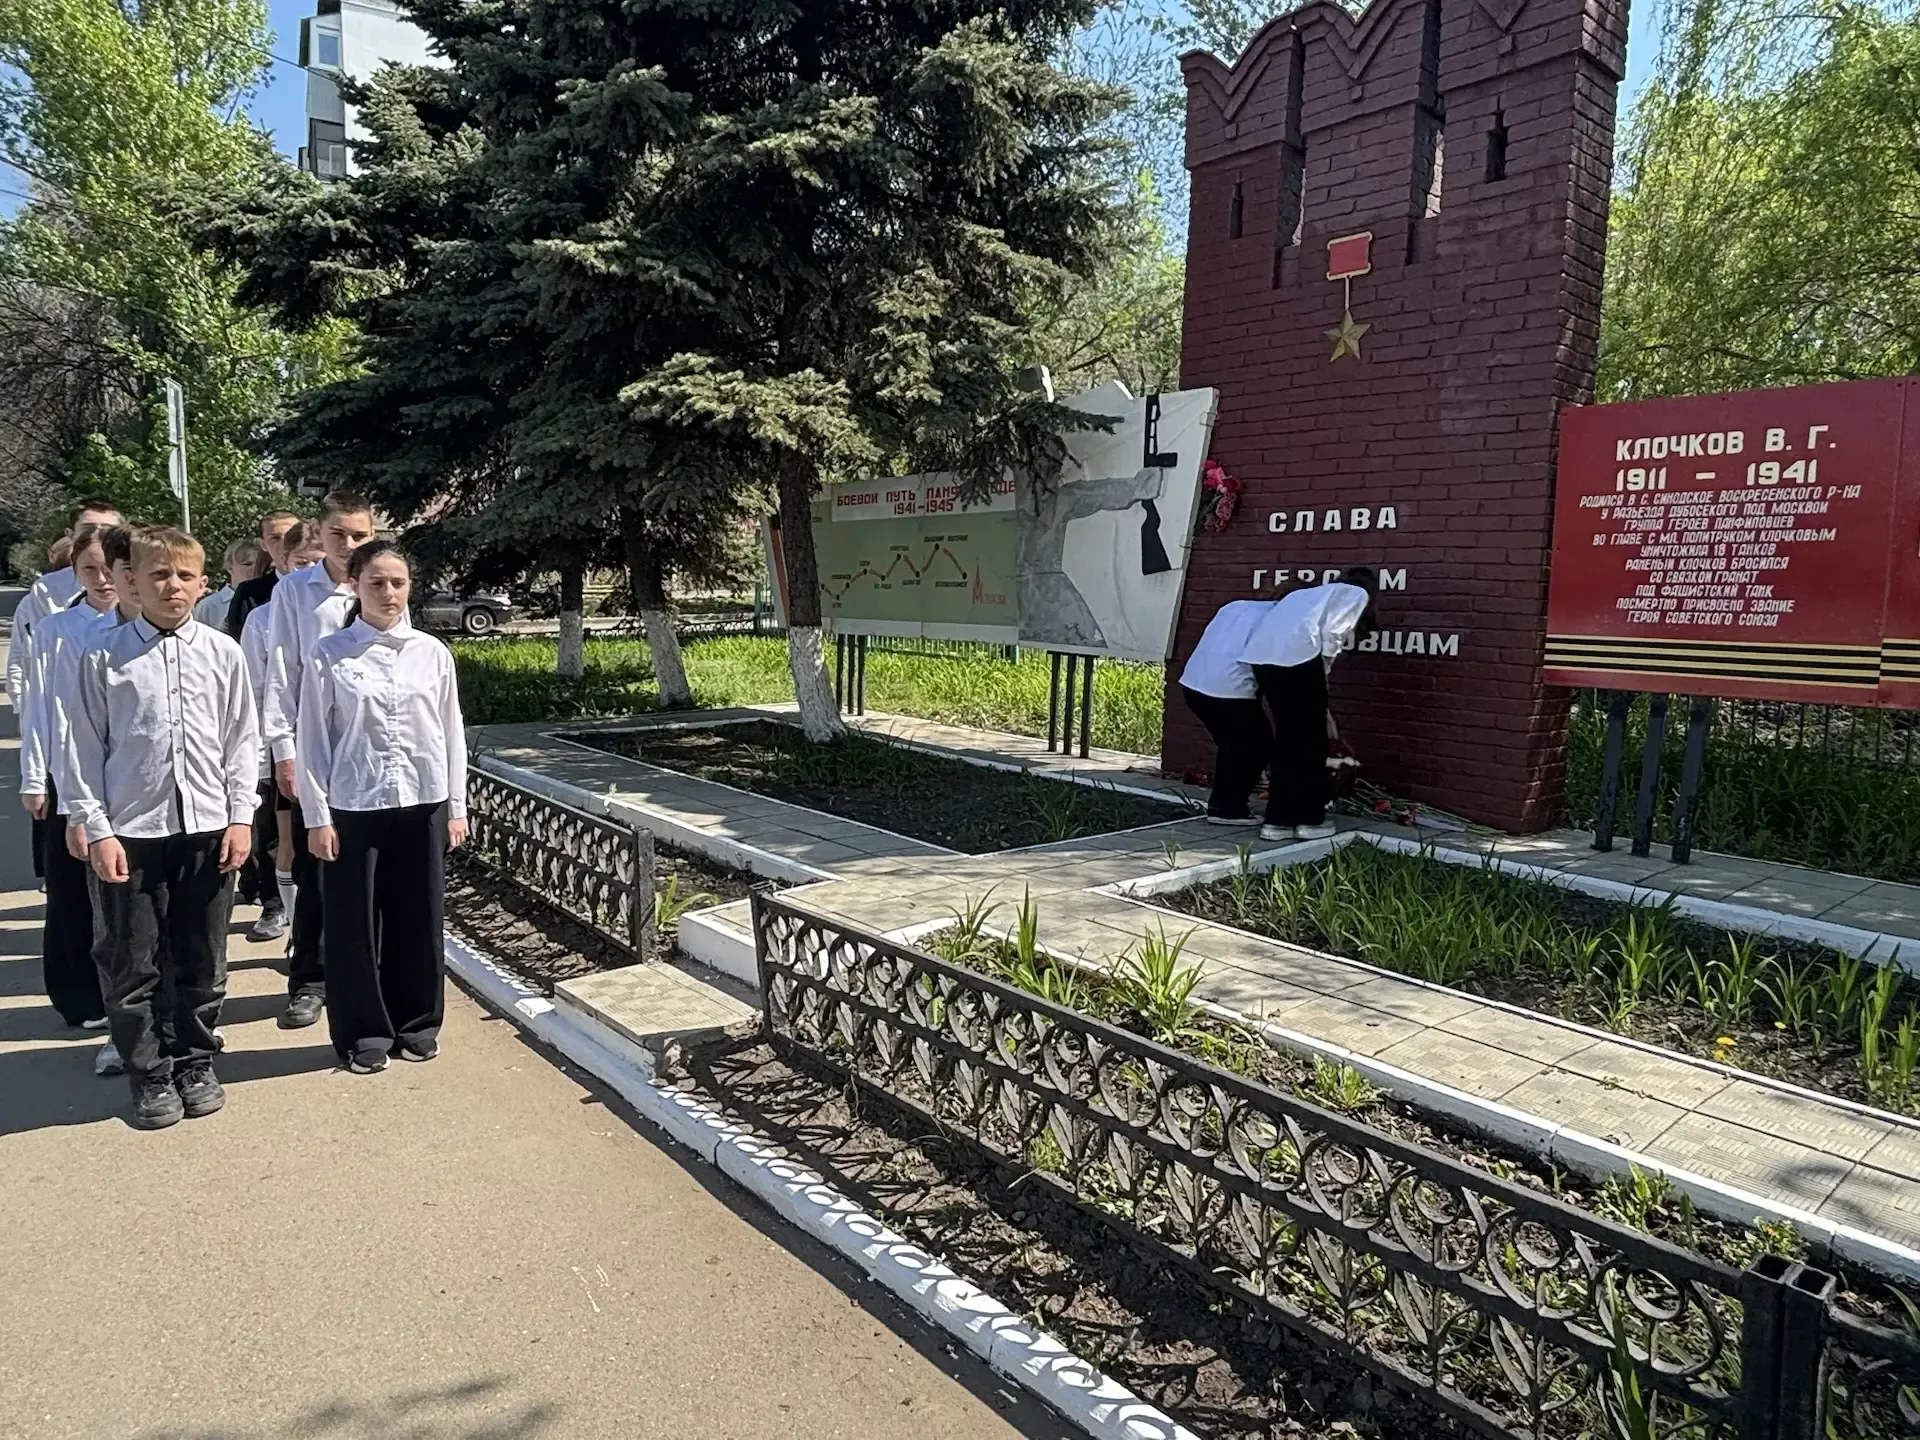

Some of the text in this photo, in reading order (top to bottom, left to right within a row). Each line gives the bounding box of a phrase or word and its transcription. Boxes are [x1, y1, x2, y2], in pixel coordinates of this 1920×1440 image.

[1616, 424, 1837, 461] КЛОЧКОВ В. Г.
[1616, 467, 1667, 491] 1911
[1747, 459, 1818, 486] 1941
[886, 489, 916, 503] ПУТЬ
[1579, 494, 1623, 508] РОДИЛСЯ
[1628, 494, 1636, 505] В
[1653, 490, 1714, 505] СИНОДСКОЕ
[1718, 487, 1822, 503] ВОСКРЕСЕНСКОГО
[1826, 485, 1862, 499] Р-НА
[1600, 508, 1608, 519] У
[1667, 503, 1737, 518] ДУБОСЕКОГО
[1743, 503, 1766, 515] ПОД
[1268, 506, 1398, 533] СЛАВА
[1623, 516, 1795, 531] ГРУППА ГЕРОЕВ ПАНФИЛОВЦЕВ
[1592, 534, 1606, 545] ВО
[1610, 533, 1643, 545] ГЛАВЕ
[1647, 532, 1656, 544] С
[1682, 529, 1756, 543] ПОЛИТРУКОМ
[1759, 527, 1837, 542] КЛОЧКОВЫМ
[1639, 543, 1777, 557] УНИЧТОЖИЛА 18 ТАНКОВ
[1678, 557, 1727, 570] КЛОЧКОВ
[1730, 556, 1790, 570] БРОСИЛСЯ
[1252, 568, 1407, 590] ГЕРОМ
[1649, 572, 1662, 583] СО
[1714, 570, 1759, 584] ГРАНАТ
[1635, 585, 1657, 597] ПОД
[1745, 585, 1774, 598] ТАНК
[1615, 598, 1796, 613] ПОСМЕРТНО ПРИСВОЕНО ЗВАНИЕ
[1626, 611, 1779, 627] ГЕРОЯ СОВЕТСКОГО СОЮЗА
